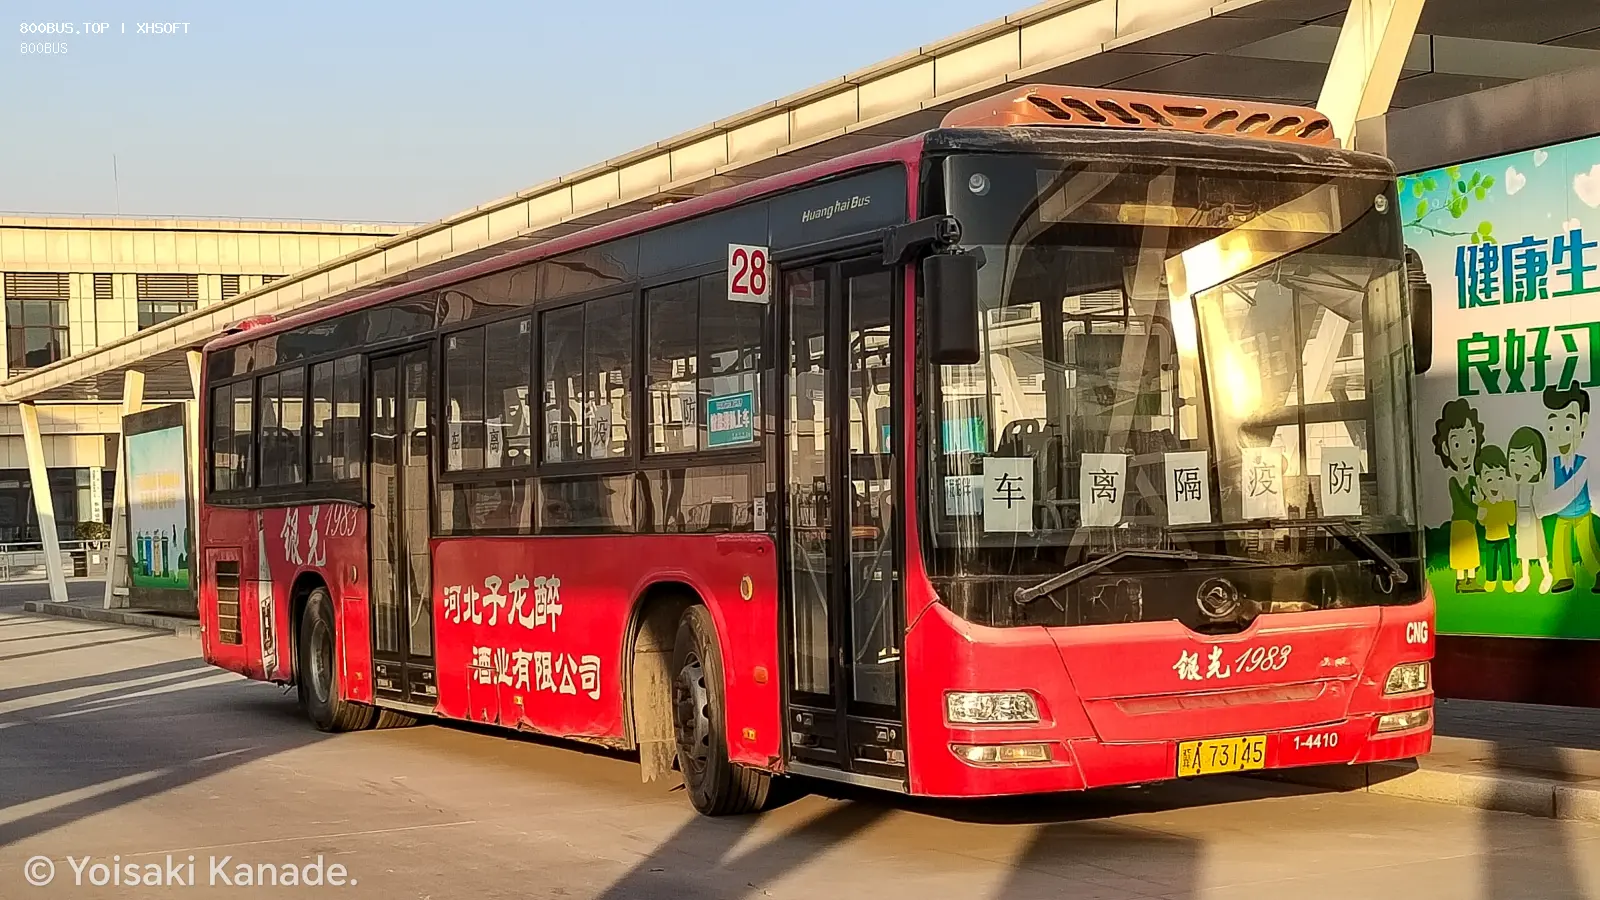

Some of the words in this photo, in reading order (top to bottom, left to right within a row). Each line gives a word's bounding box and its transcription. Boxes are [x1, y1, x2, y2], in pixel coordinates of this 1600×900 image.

[731, 248, 767, 296] 28
[1405, 620, 1429, 645] CNG
[472, 645, 601, 701] 酒业有限公司
[1293, 732, 1338, 750] 1-4410
